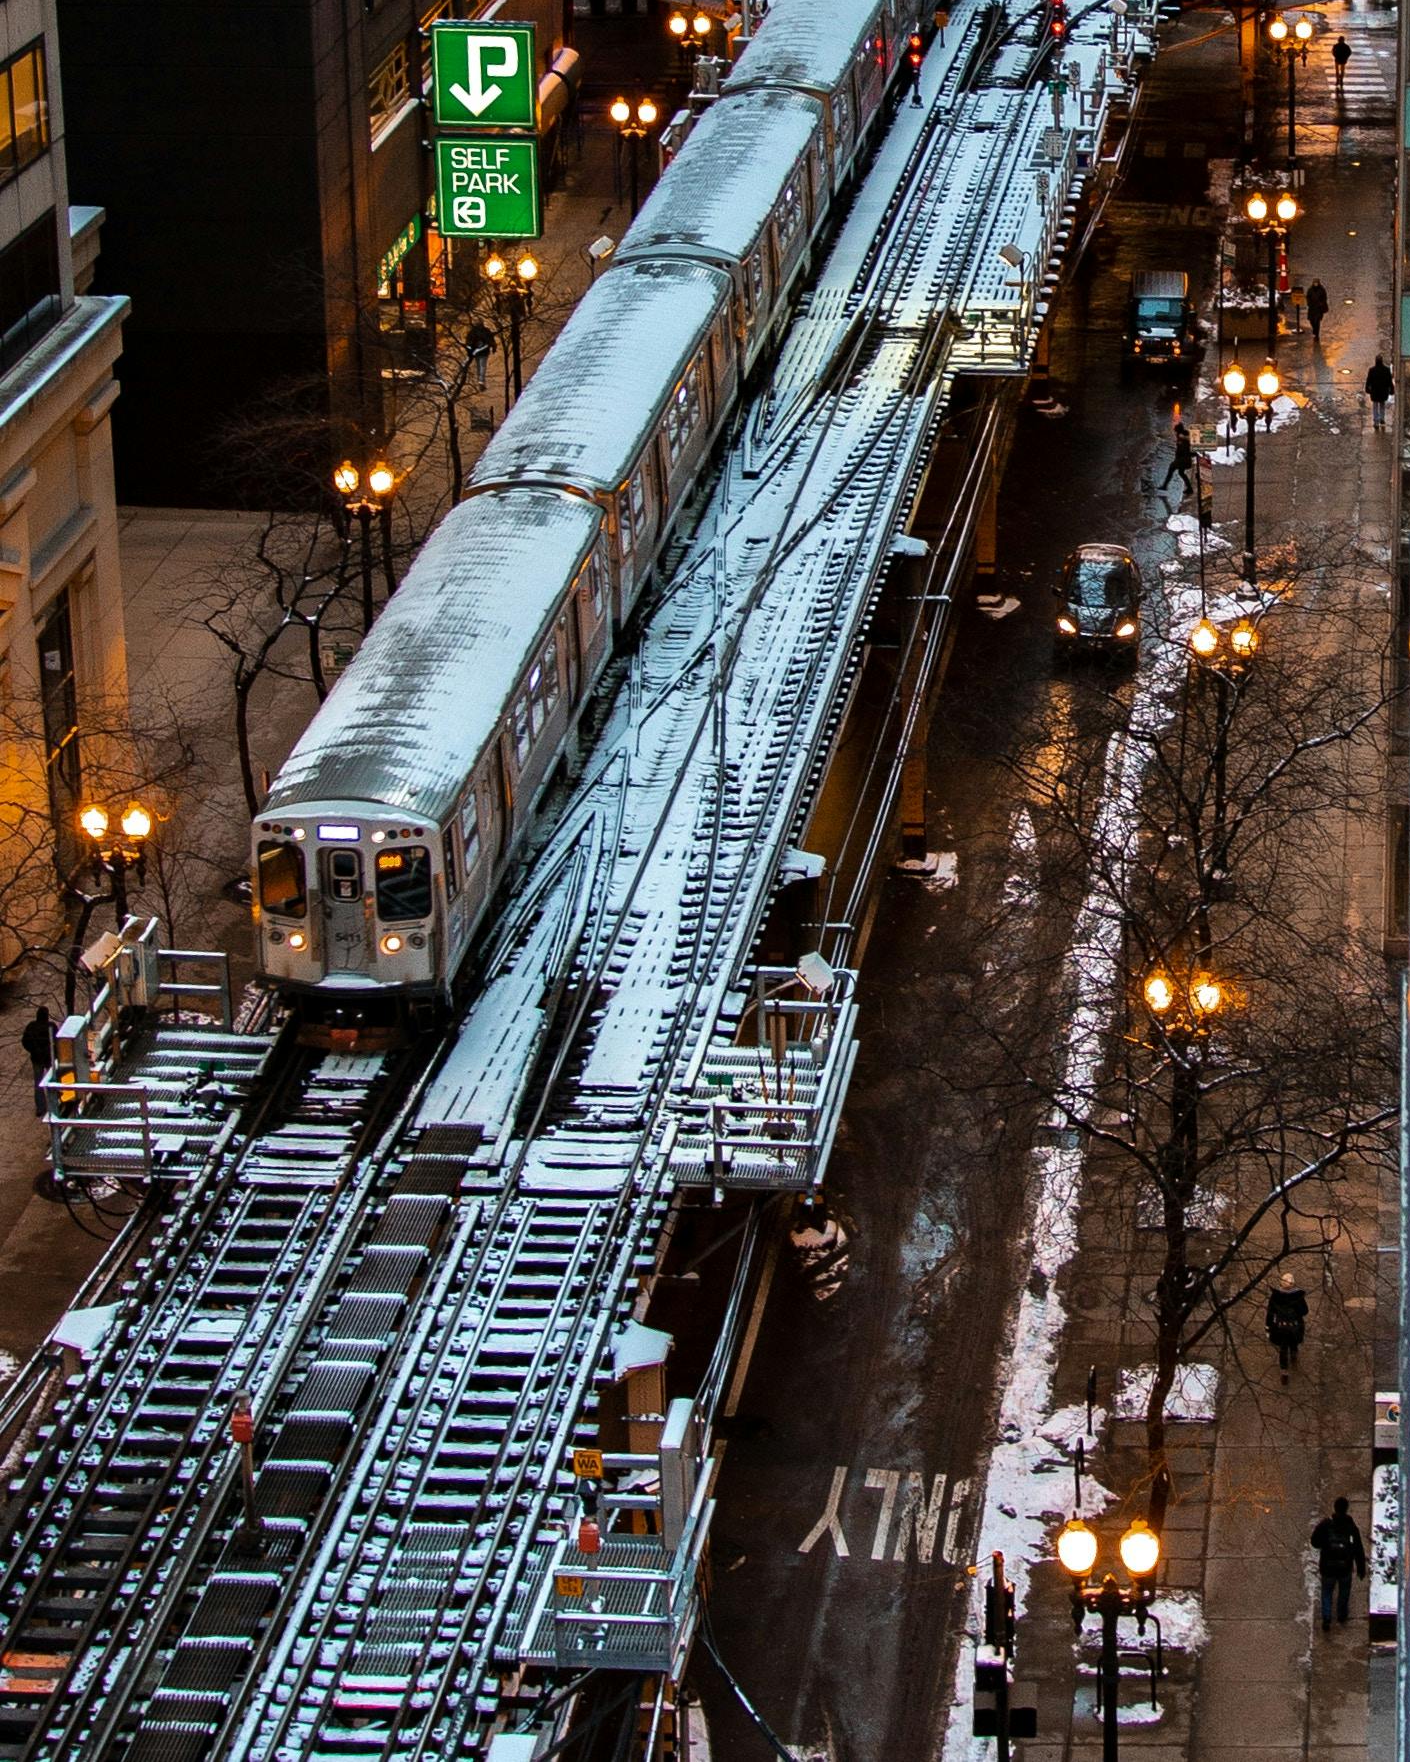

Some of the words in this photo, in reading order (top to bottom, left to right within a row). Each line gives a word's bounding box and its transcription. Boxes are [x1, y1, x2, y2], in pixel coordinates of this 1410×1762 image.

[449, 35, 519, 117] P
[451, 147, 510, 170] SELF
[452, 172, 521, 195] PARK
